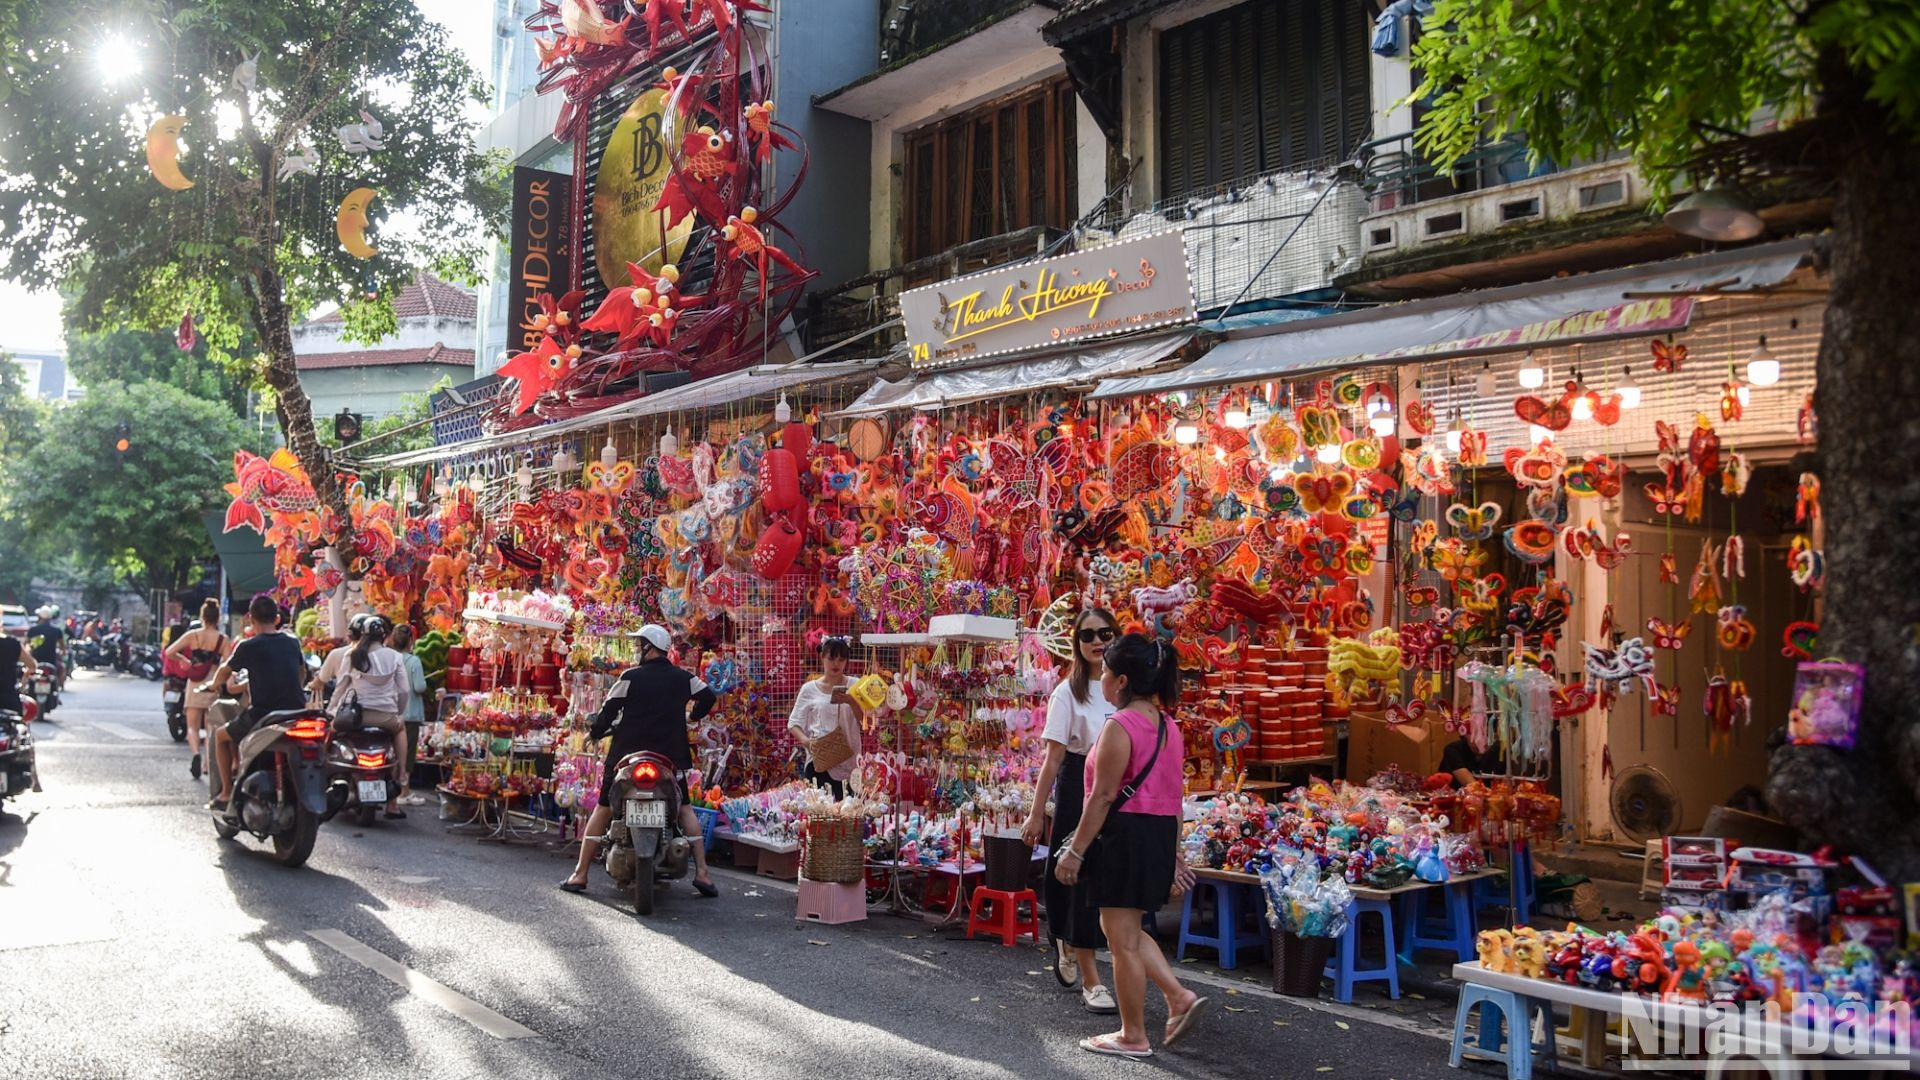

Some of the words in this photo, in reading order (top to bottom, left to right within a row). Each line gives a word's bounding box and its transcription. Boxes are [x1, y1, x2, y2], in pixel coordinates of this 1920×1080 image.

[948, 284, 1014, 334] Thanh
[1116, 278, 1152, 294] Decor
[913, 342, 929, 362] 74
